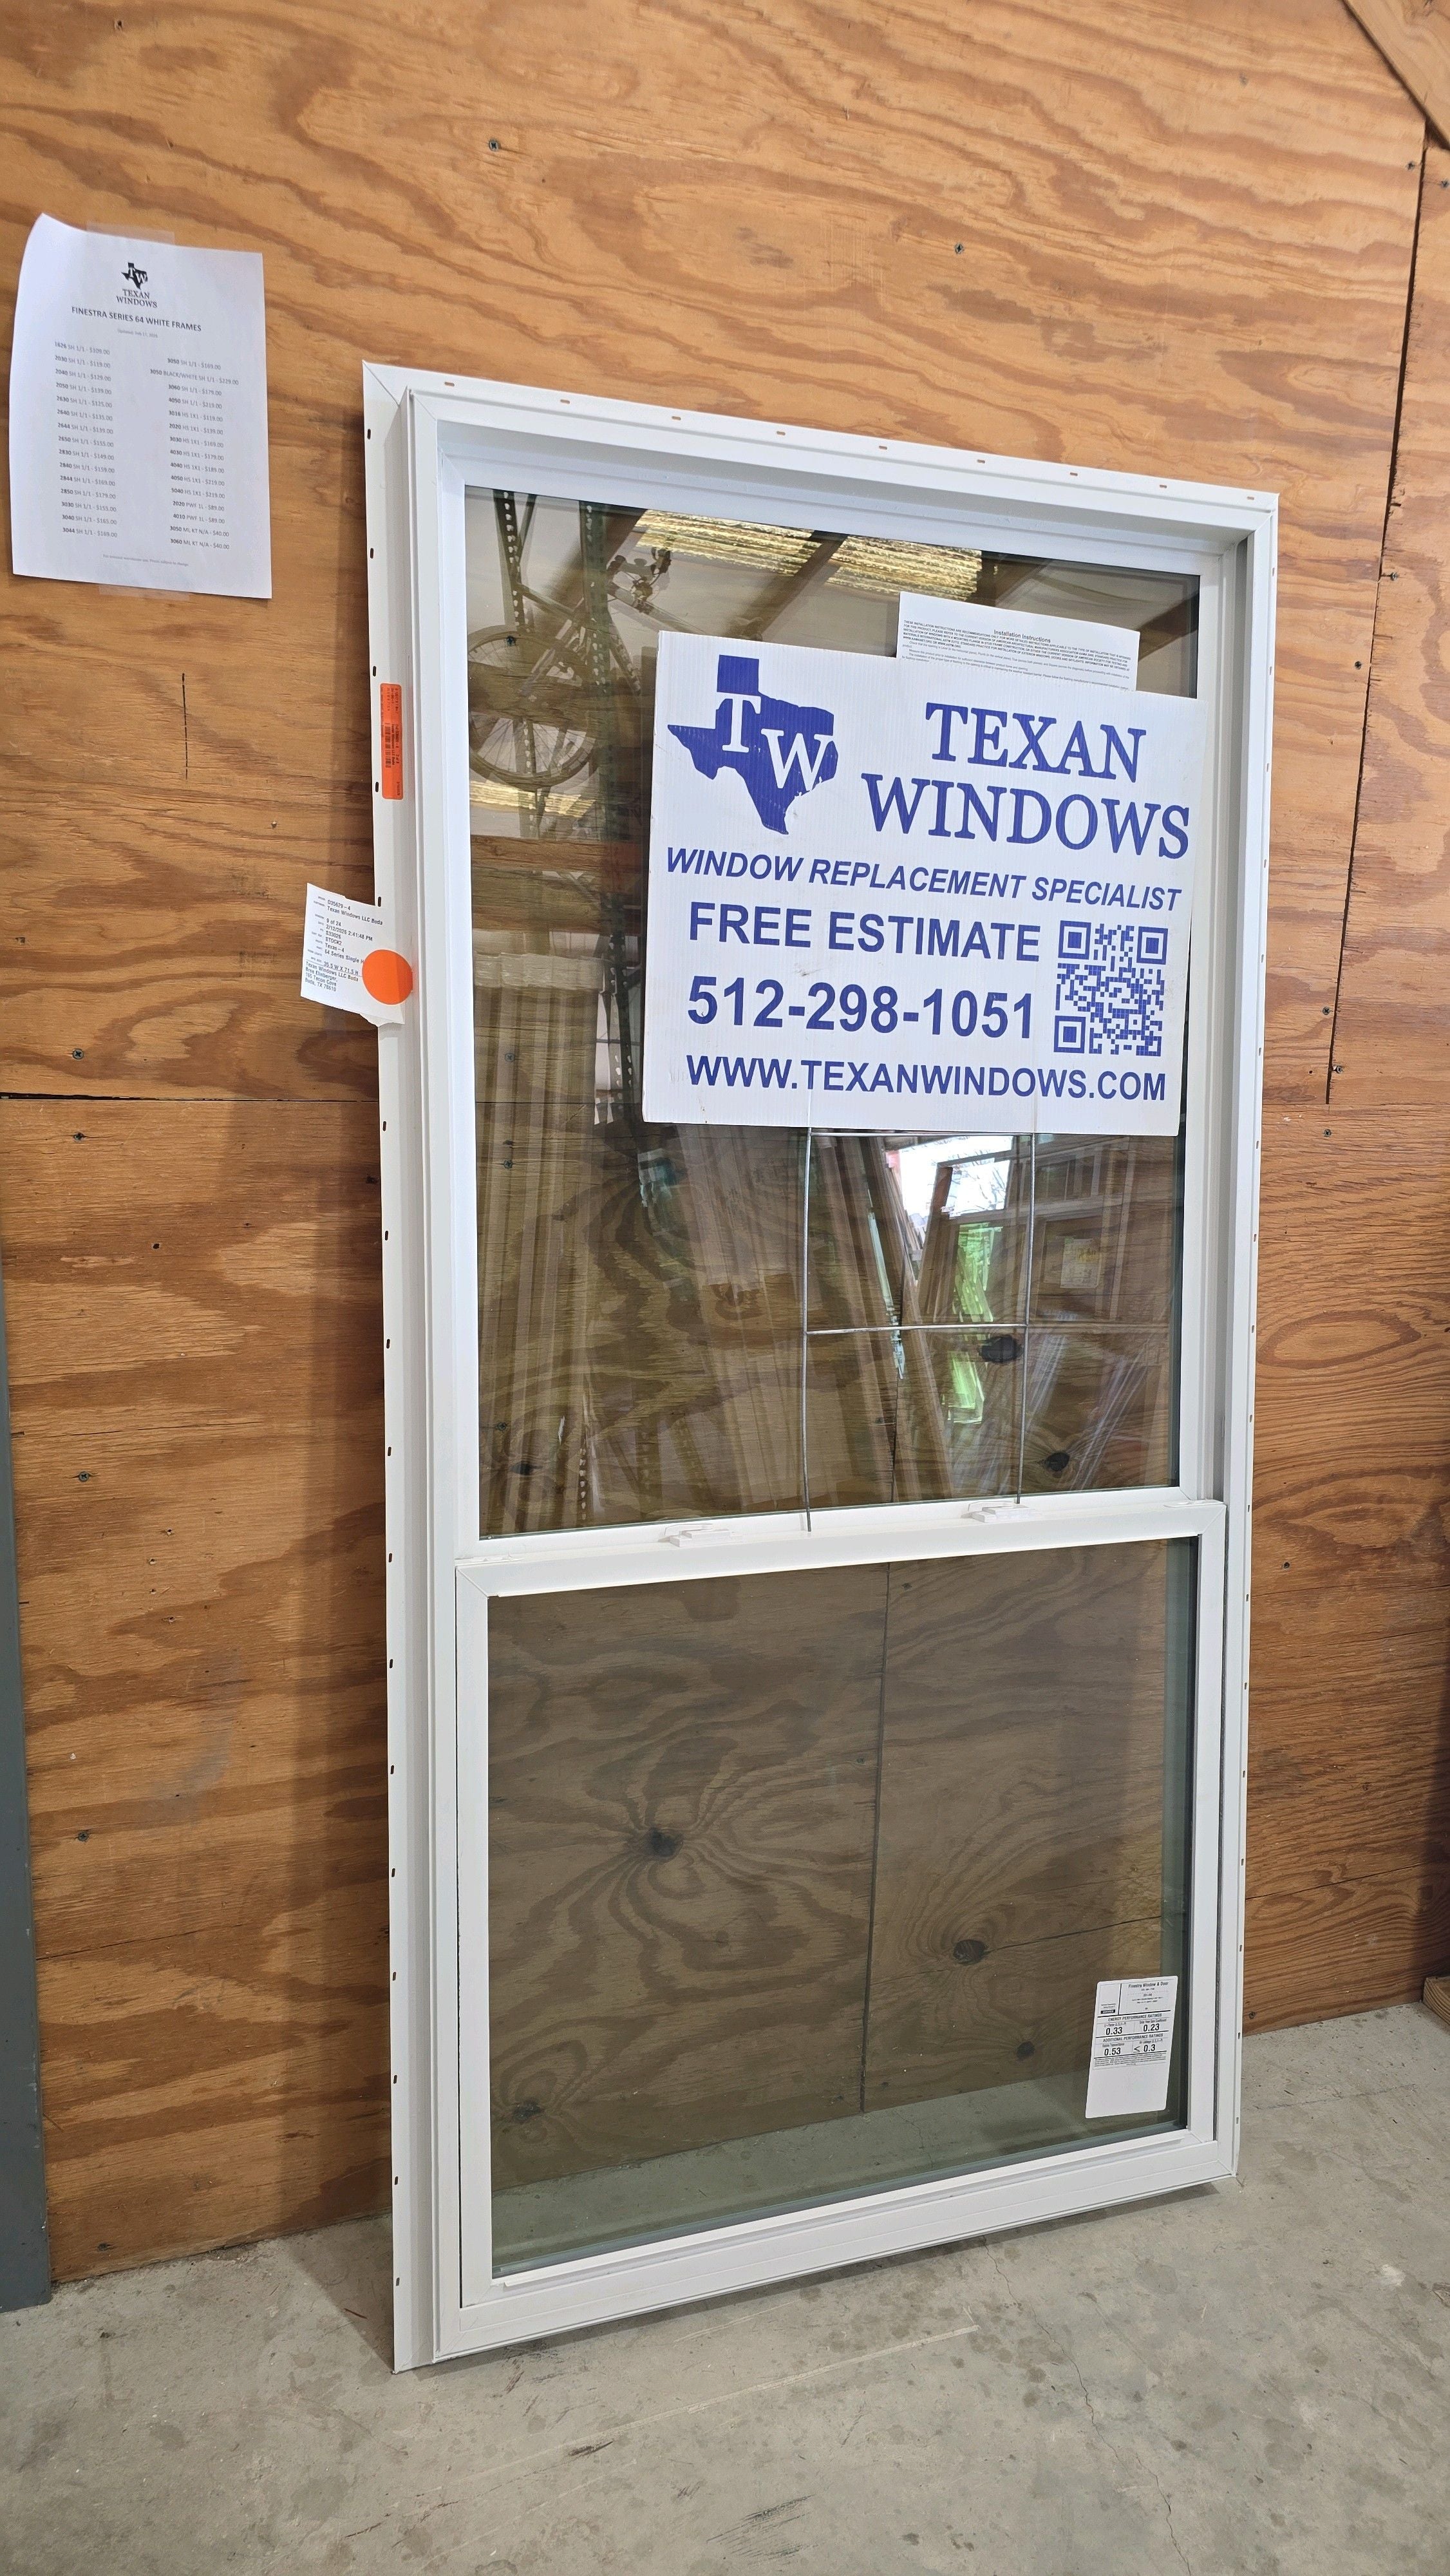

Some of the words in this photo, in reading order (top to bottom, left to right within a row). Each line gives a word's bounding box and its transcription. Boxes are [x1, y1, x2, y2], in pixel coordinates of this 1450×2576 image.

[122, 289, 150, 299] TEXAN
[116, 296, 157, 308] WINDOWS
[71, 307, 107, 318] FINESTRA
[109, 312, 133, 321] SERIES
[146, 317, 170, 327] WHITE
[172, 321, 202, 332] FRAMES
[164, 371, 199, 381] BLACK/WHITE
[994, 629, 1021, 638] Installation
[1022, 634, 1051, 643] Instructions
[926, 703, 1146, 782] TEXAN
[862, 773, 1189, 858] WINDOWS
[668, 848, 804, 881] WINDOW
[809, 859, 1026, 896] REPLACEMENT
[1033, 877, 1182, 909] SPECIALIST
[341, 910, 360, 920] Windows
[690, 902, 811, 947] FREE
[829, 912, 1040, 961] ESTIMATE
[688, 976, 1031, 1038] 512-298-1051
[687, 1056, 1165, 1100] WWW.TEXANWINDOWS.COM
[1106, 2027, 1122, 2035] 0.33
[1144, 2023, 1160, 2032] 0.23
[1104, 2047, 1120, 2056] 0.53
